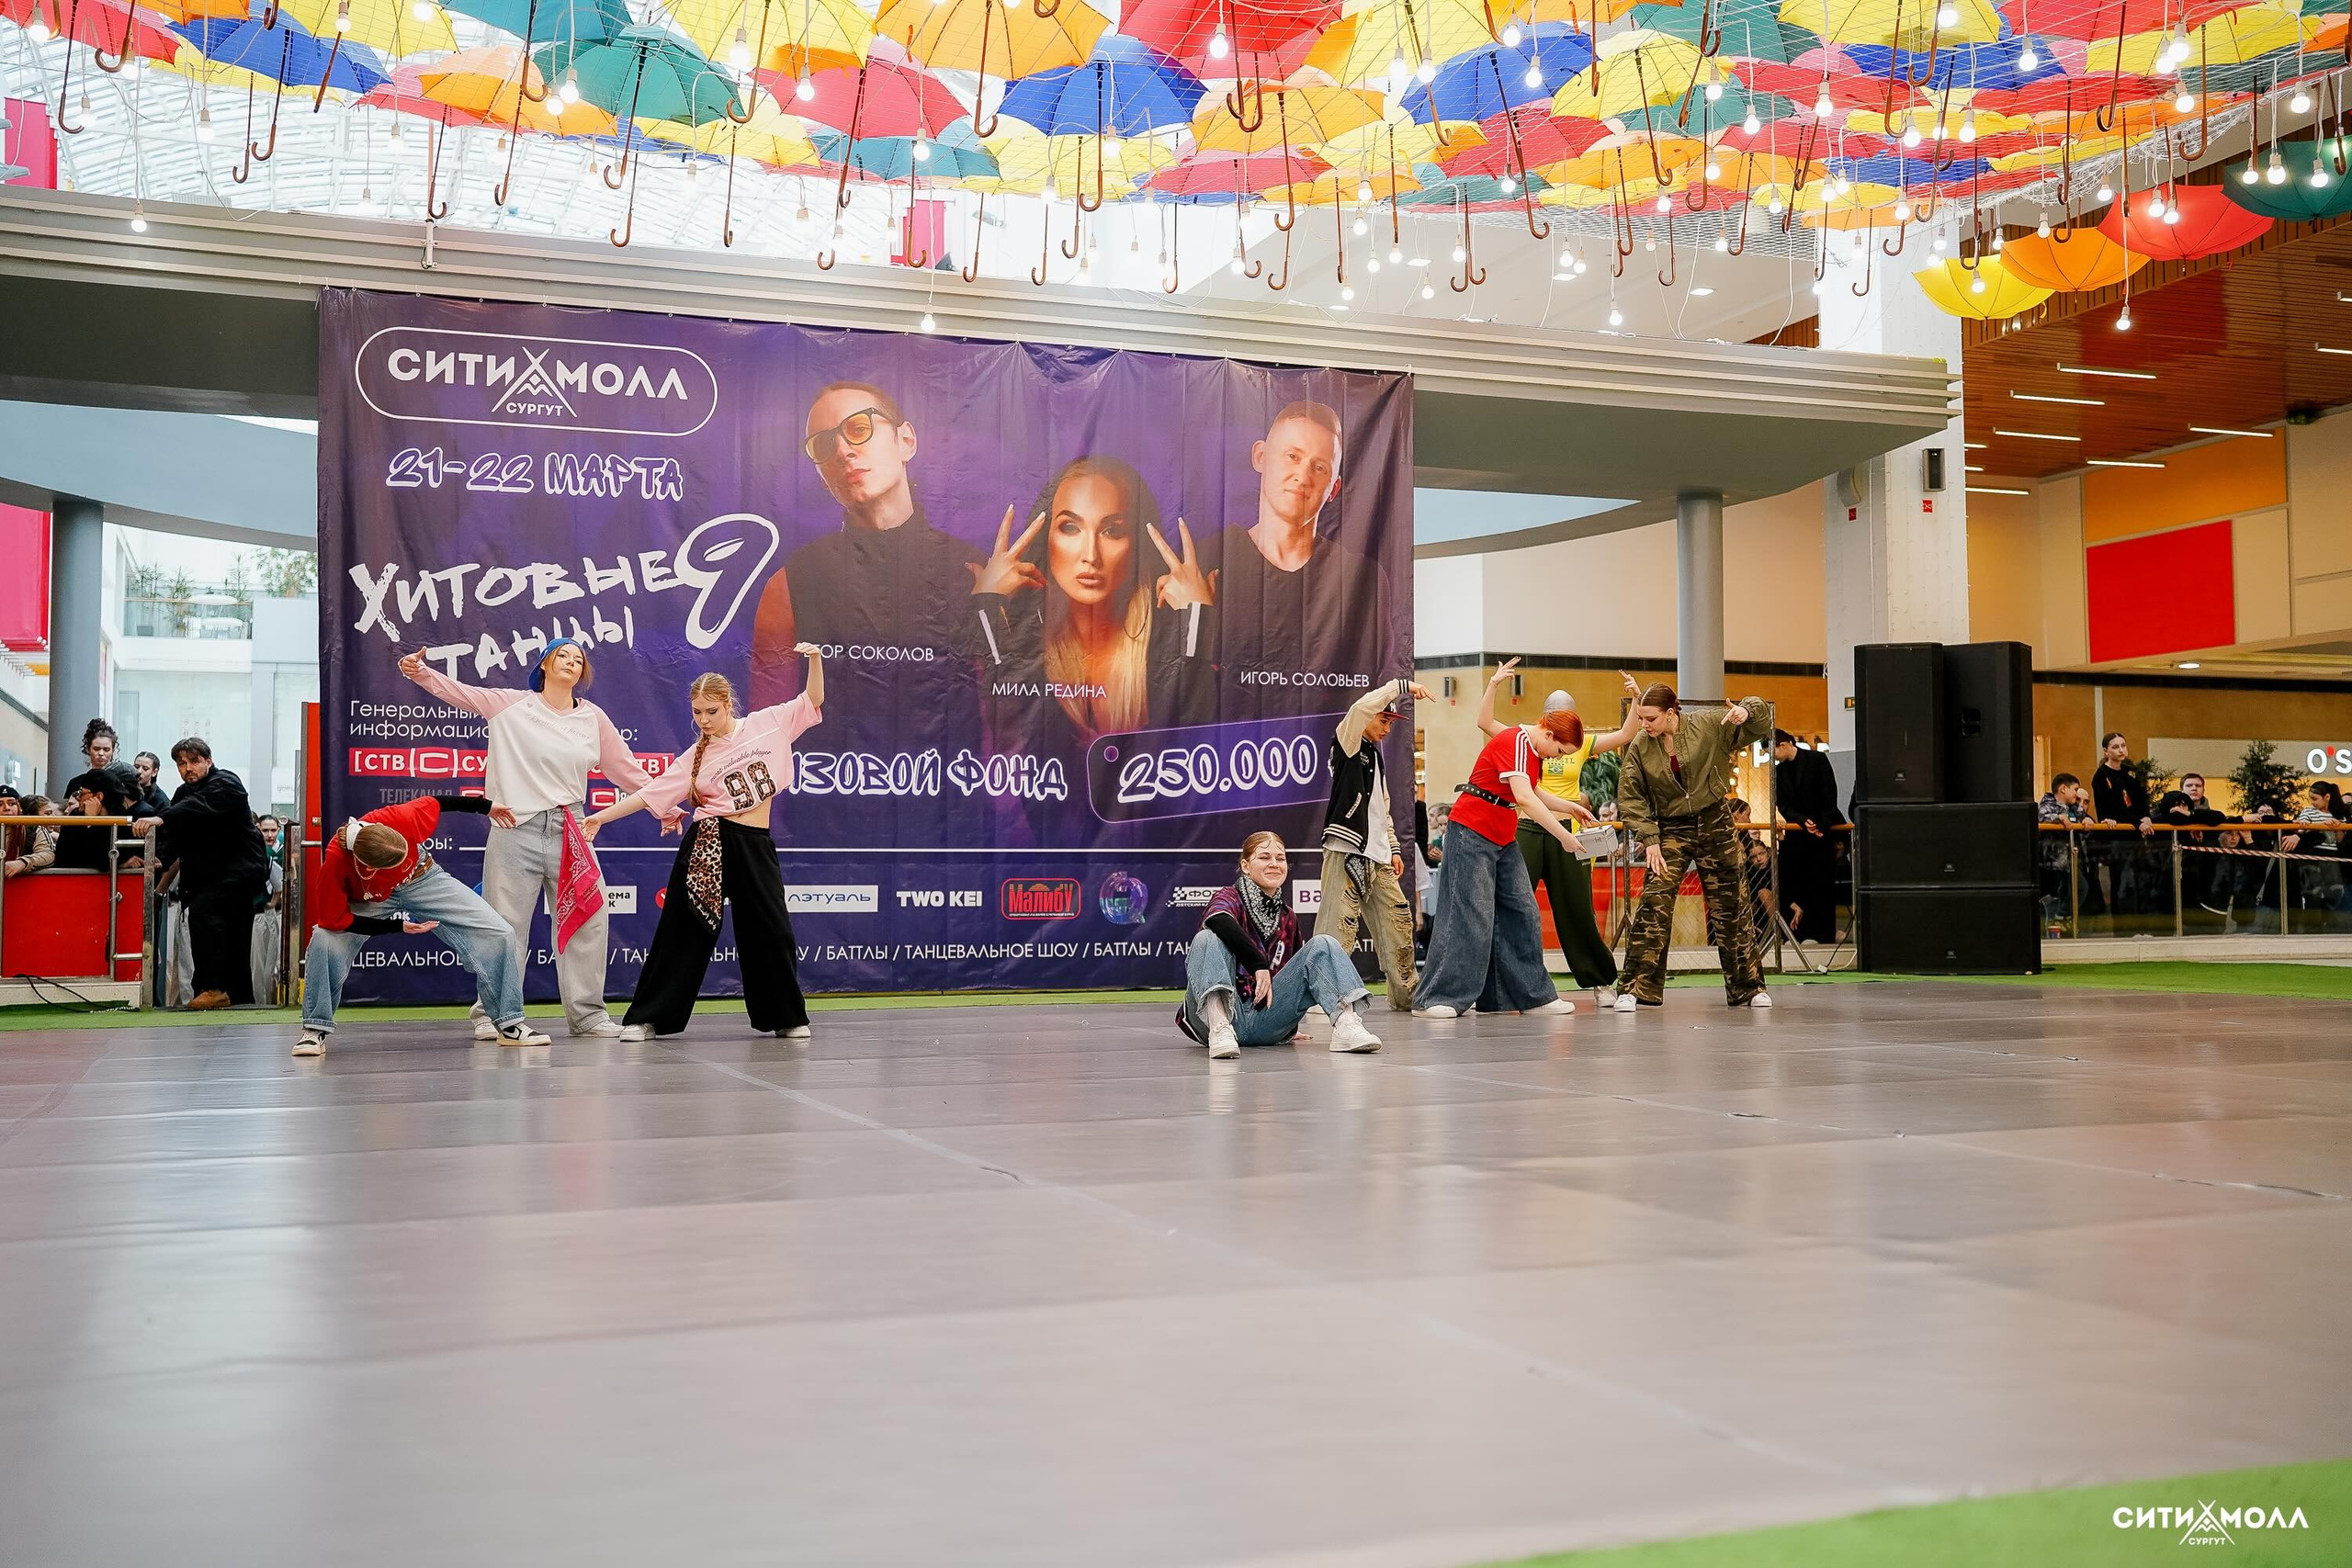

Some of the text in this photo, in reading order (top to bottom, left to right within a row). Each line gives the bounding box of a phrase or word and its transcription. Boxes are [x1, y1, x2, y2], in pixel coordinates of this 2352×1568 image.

[505, 401, 563, 417] СУРГУТ
[386, 446, 684, 502] 21-22 МАРТА
[848, 645, 934, 661] СОКОЛОВ
[1240, 671, 1370, 687] ИГОРЬ СОЛОВЬЕВ
[991, 682, 1107, 699] МИЛА РЕДИНА
[350, 700, 484, 720] Генеральны
[349, 720, 489, 739] информацио
[724, 750, 750, 769] valuable
[750, 748, 773, 759] player
[789, 748, 1068, 802] ЗОВОЙ ФОНД
[1116, 734, 1318, 804] 250.000
[723, 761, 777, 811] 98
[896, 890, 983, 908] TWO KEI
[826, 945, 888, 961] БАТТЛЫ
[904, 942, 1034, 961] ТАНЦЕВАЛЬНОЕ
[1037, 942, 1079, 958] ШОУ
[1093, 942, 1151, 957] БАТТЛЫ
